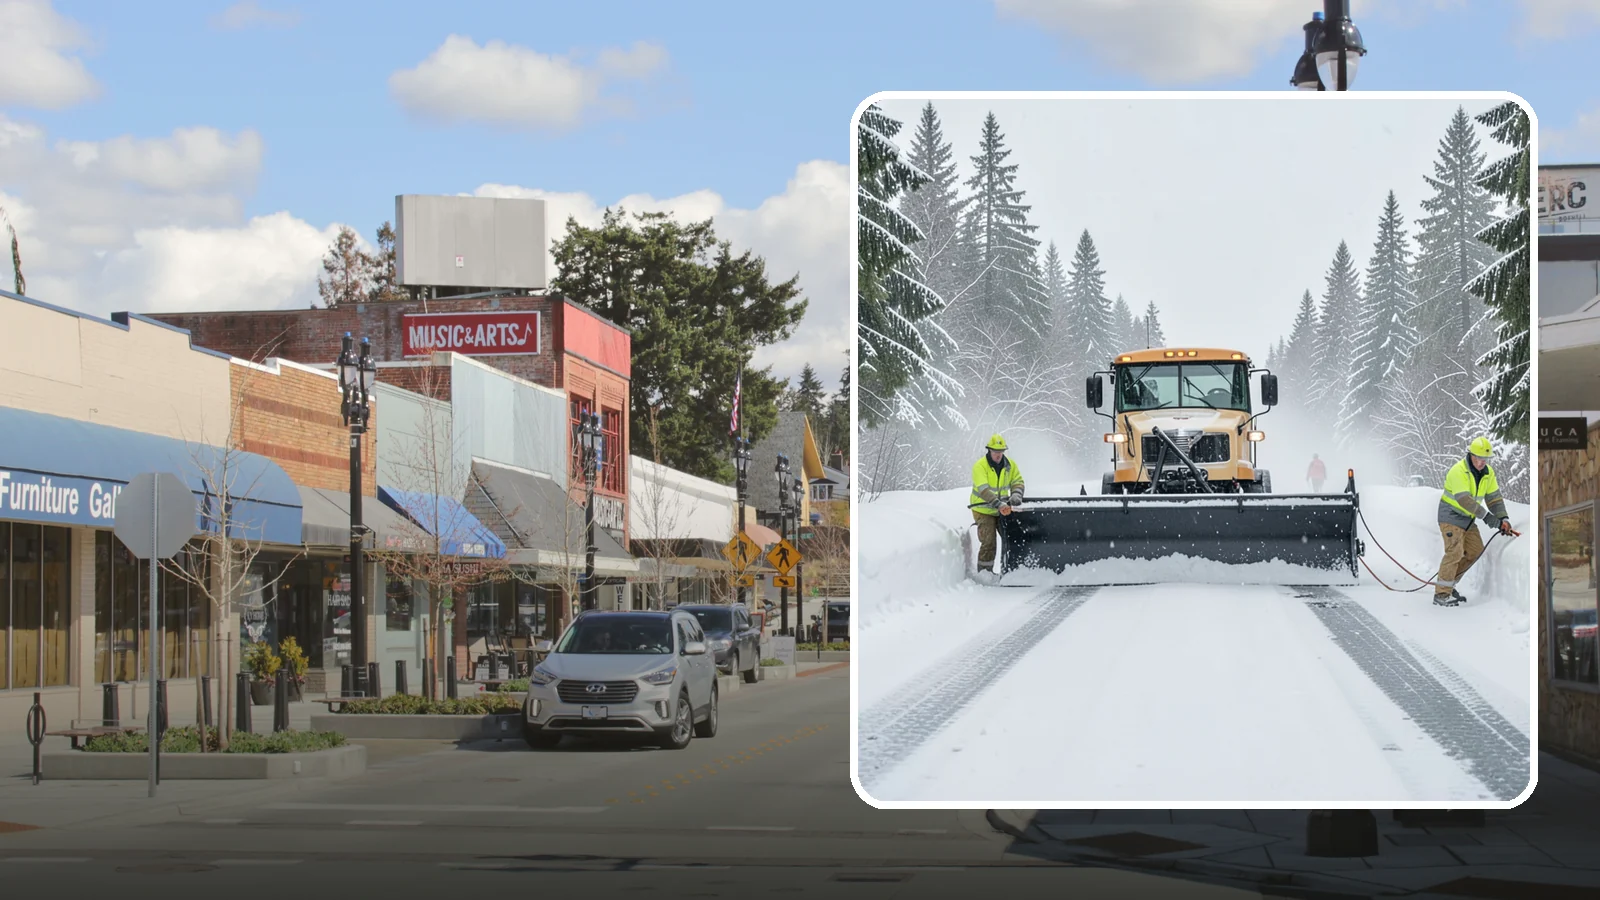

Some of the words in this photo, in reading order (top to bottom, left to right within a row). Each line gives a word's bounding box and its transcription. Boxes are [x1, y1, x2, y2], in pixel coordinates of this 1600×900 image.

[409, 322, 519, 349] MUSIC&ARTS
[1540, 427, 1577, 436] UGA
[0, 471, 79, 515] Furniture
[453, 563, 479, 574] SUSHI
